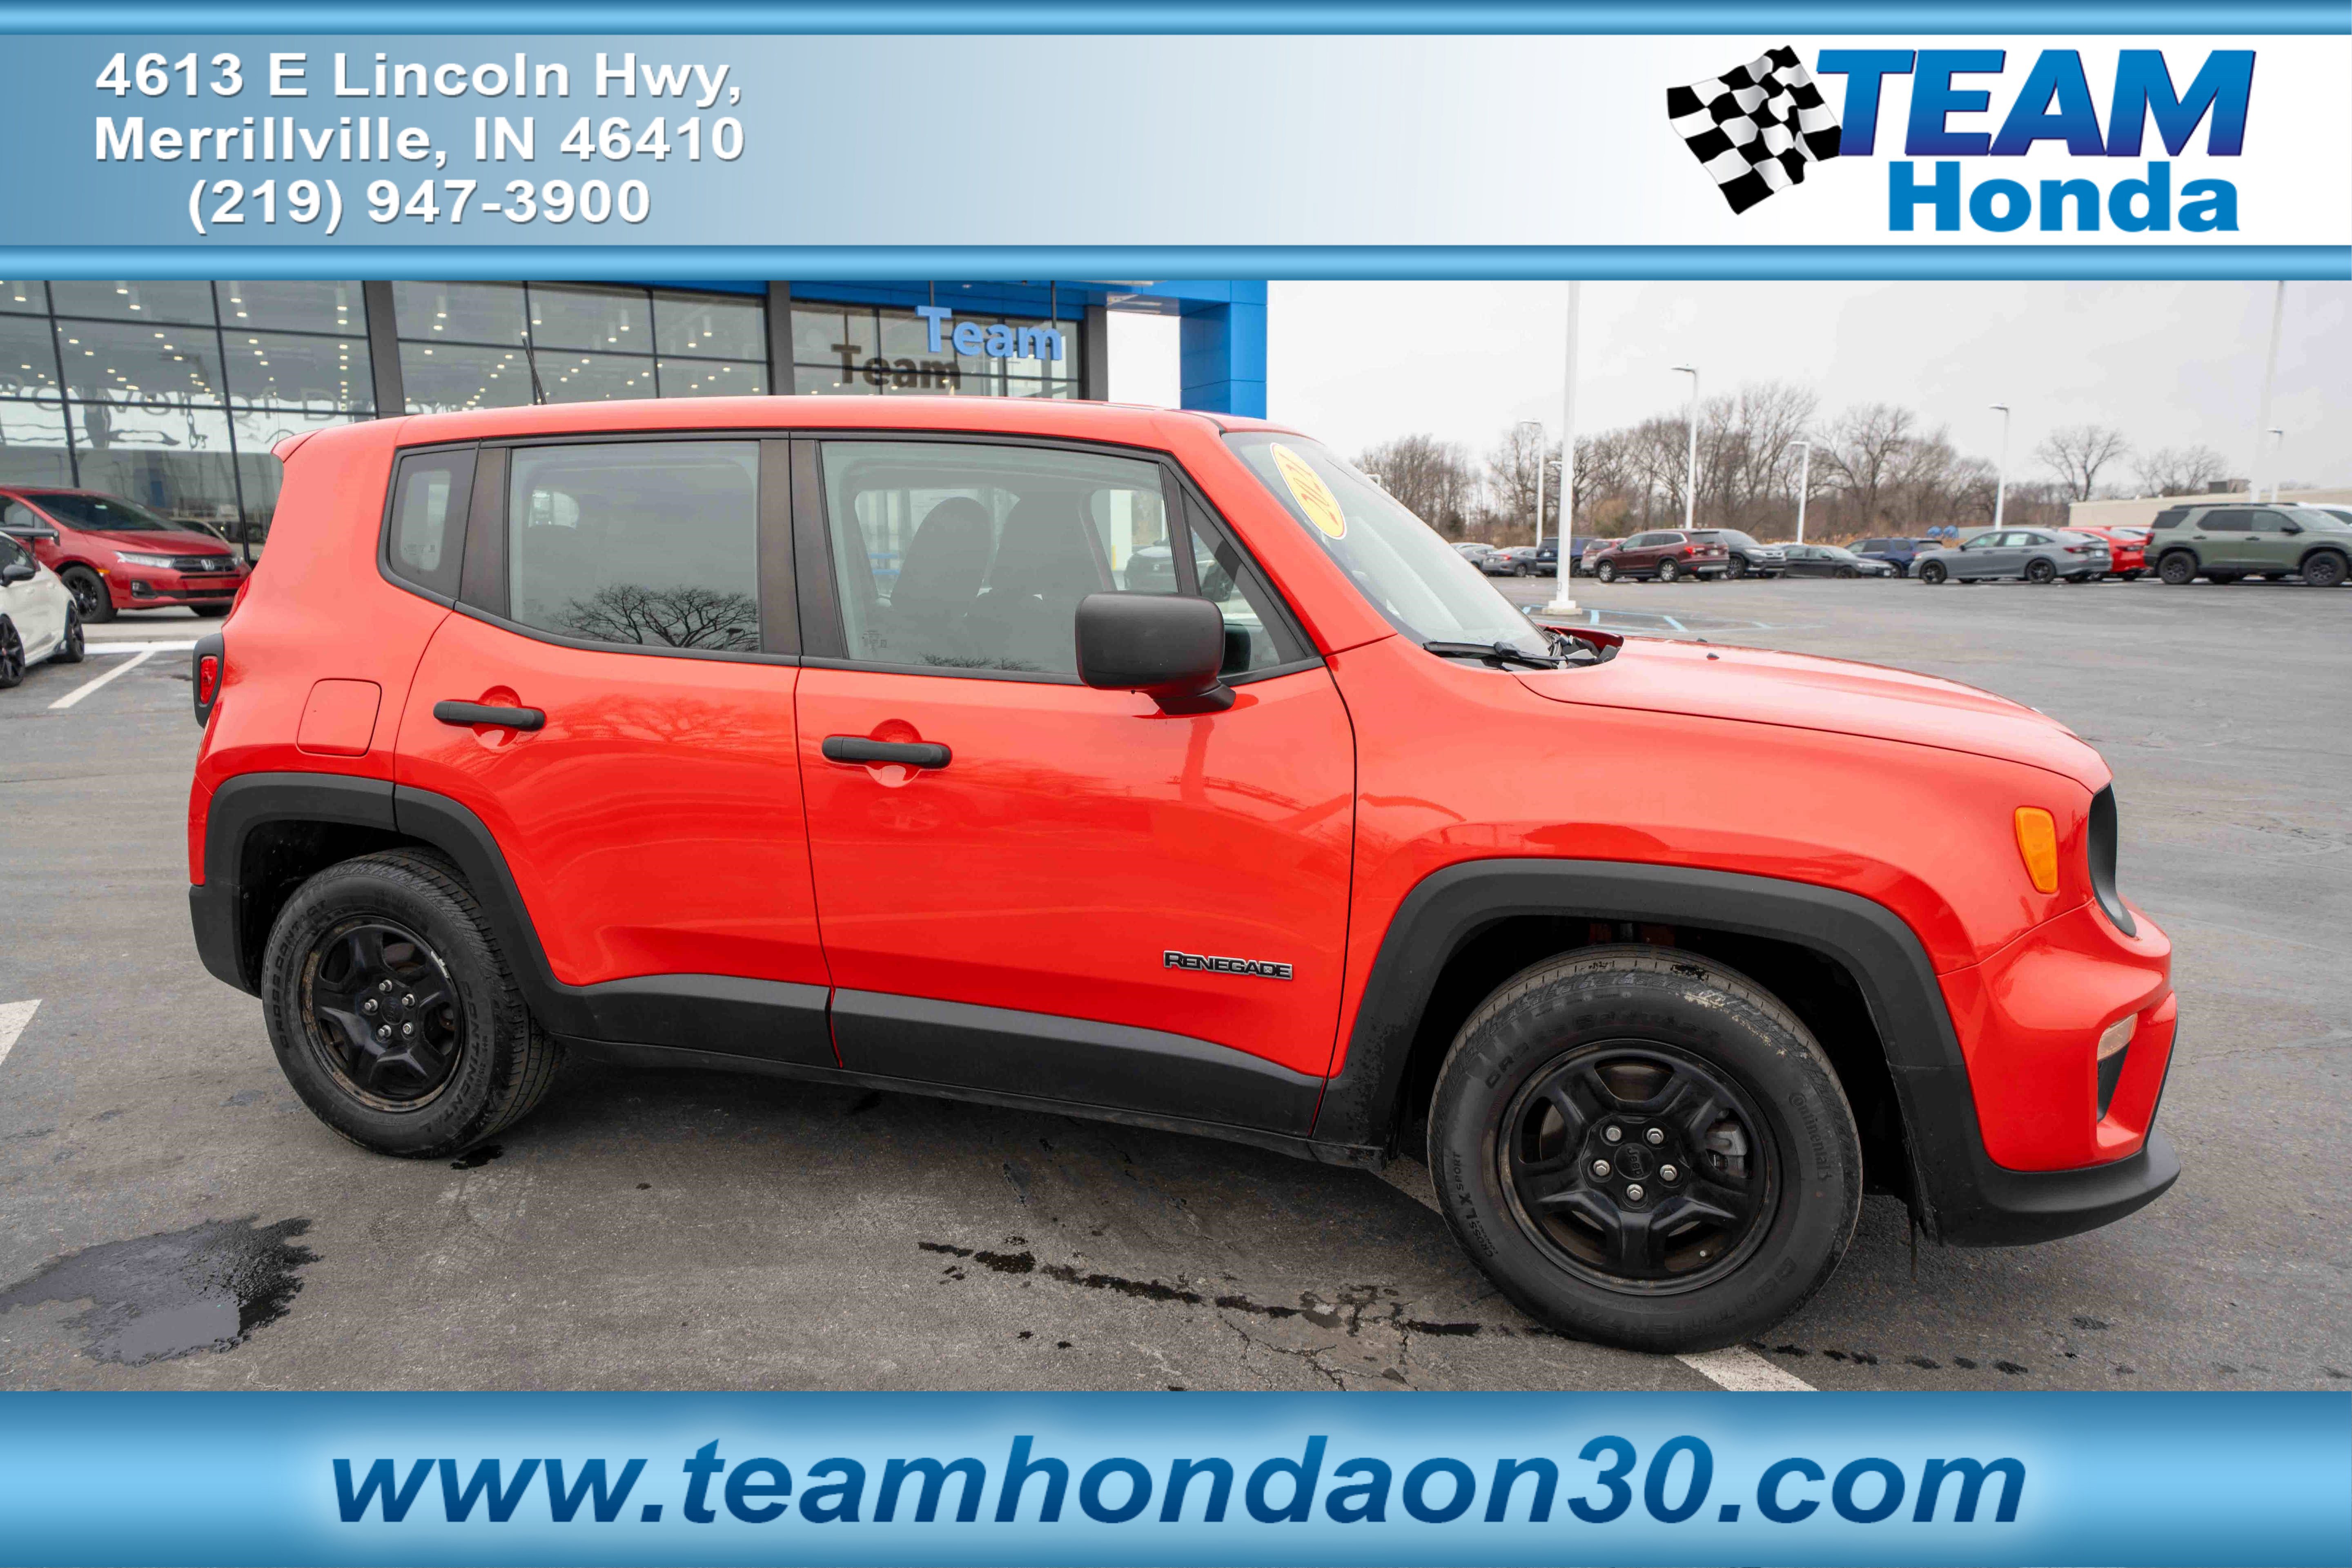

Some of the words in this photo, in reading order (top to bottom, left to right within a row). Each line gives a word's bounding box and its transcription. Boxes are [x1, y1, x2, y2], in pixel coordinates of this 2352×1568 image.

[915, 305, 1062, 361] Team
[831, 343, 961, 390] Team
[1163, 950, 1293, 980] RENEGADE
[1453, 1152, 1464, 1191] SPORT
[1626, 1147, 1643, 1175] Jeep
[1469, 1221, 1493, 1257] CROSS
